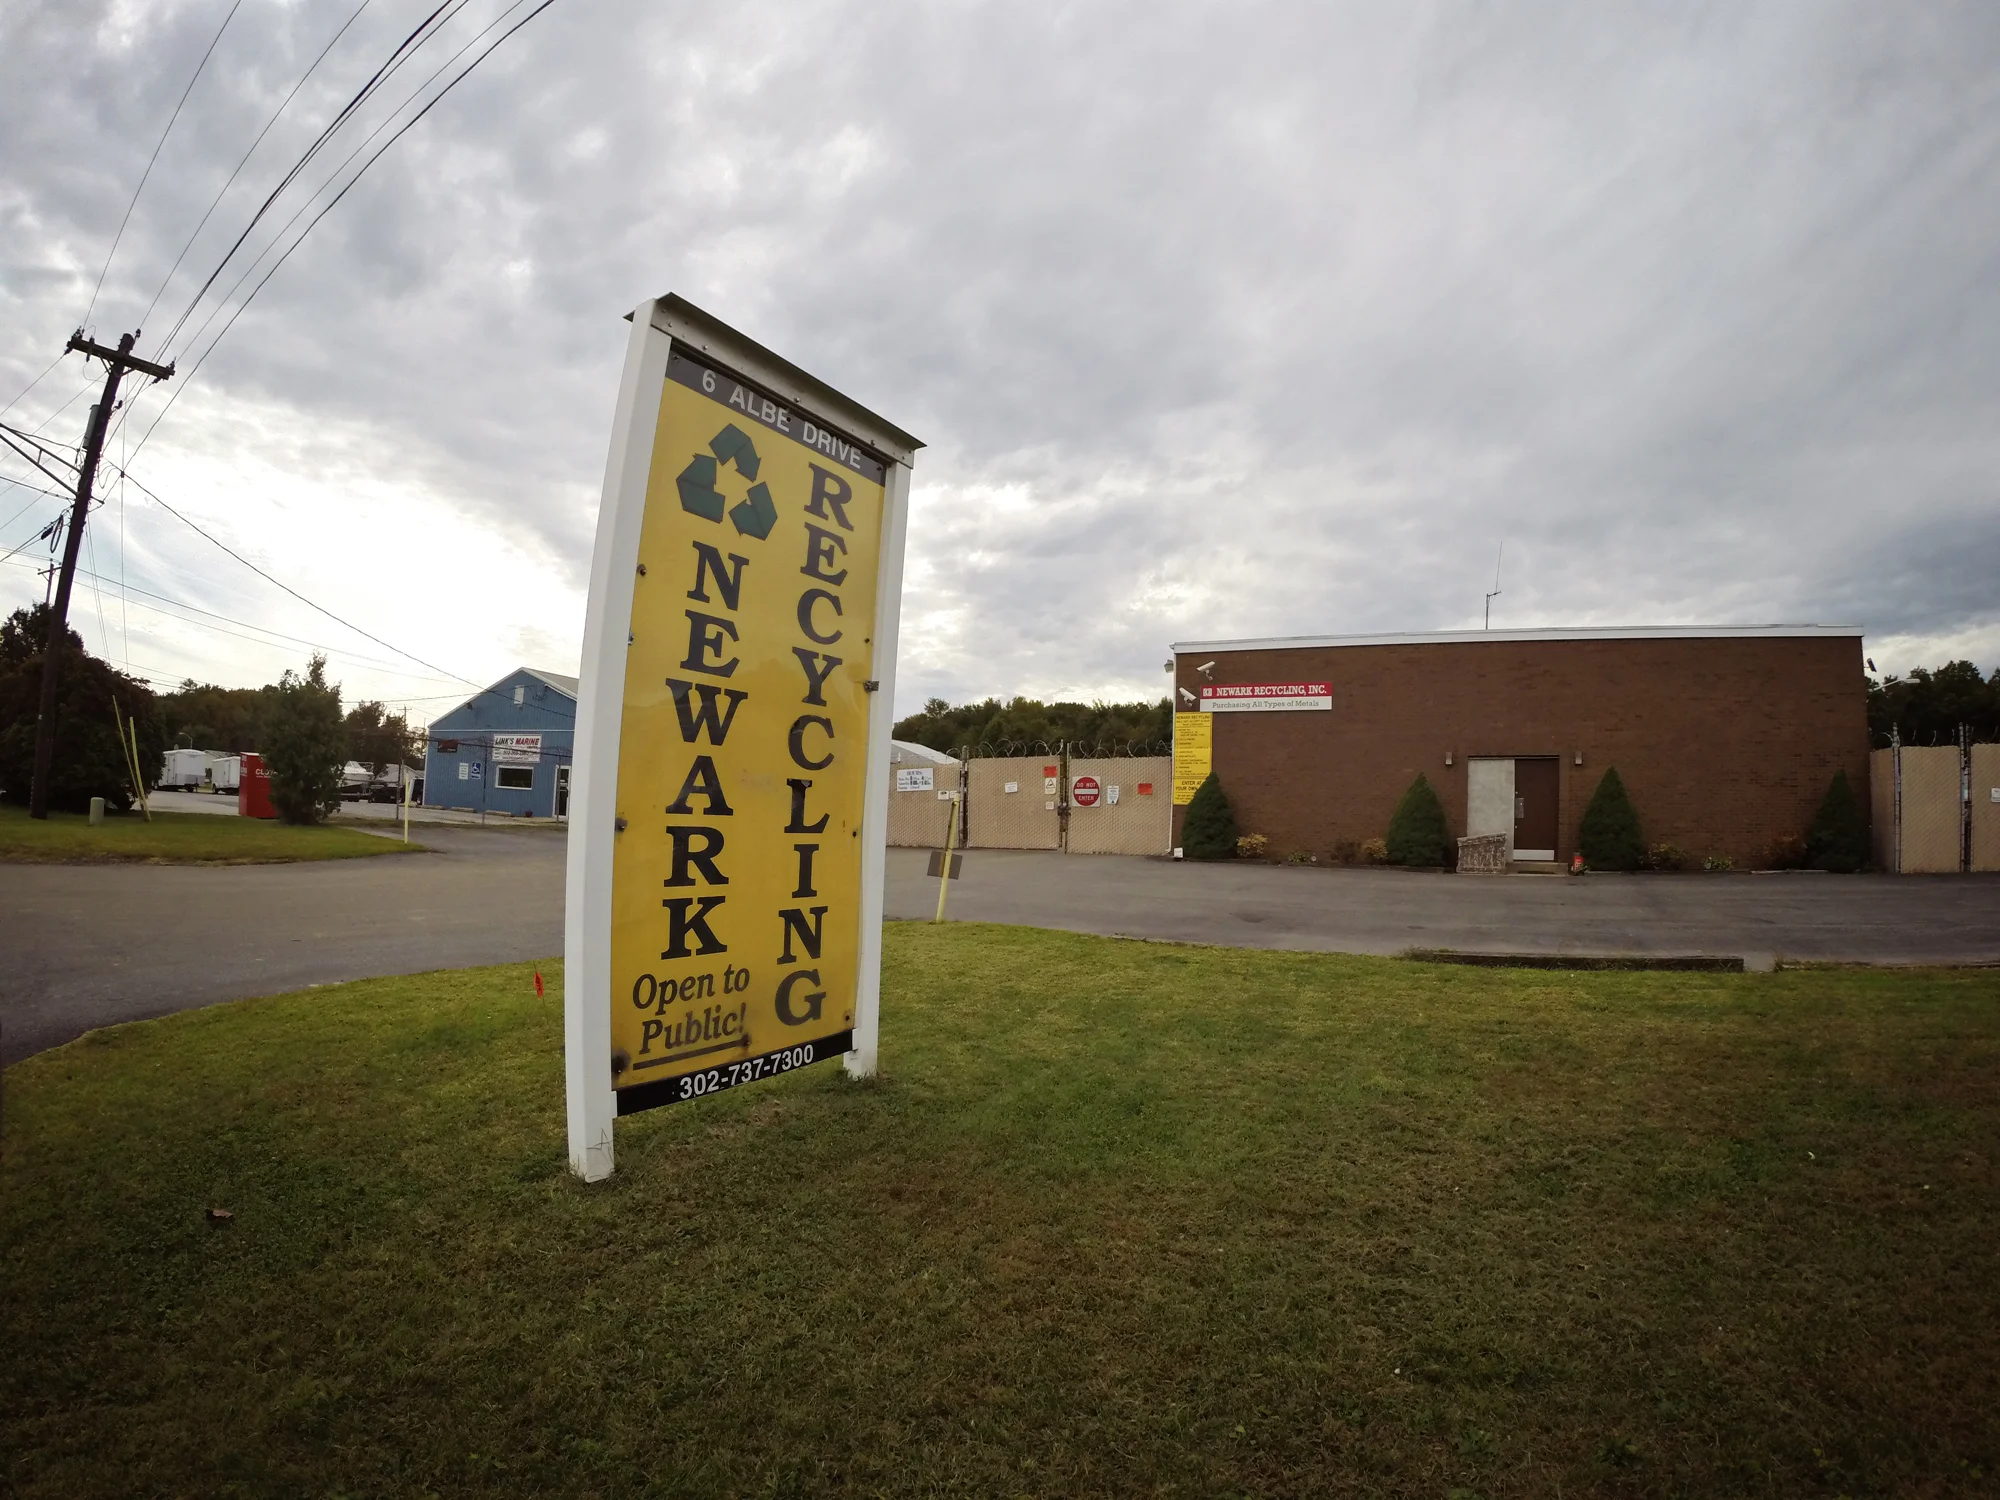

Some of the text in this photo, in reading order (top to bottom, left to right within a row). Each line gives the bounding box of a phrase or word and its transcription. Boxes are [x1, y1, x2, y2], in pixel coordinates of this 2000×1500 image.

[702, 369, 861, 469] 6 ALBE DRIVE
[1212, 701, 1251, 709] Purchasing
[1264, 700, 1285, 709] Types
[1295, 699, 1319, 707] Metals
[1216, 684, 1327, 697] NEWARK RECYCLING, INC.
[515, 737, 540, 746] MARINE
[661, 540, 749, 960] NEWARK
[775, 462, 854, 1026] RECYCLING
[632, 963, 750, 1016] Open to
[638, 1002, 747, 1055] Public!
[679, 1044, 814, 1100] 302-737-7300
